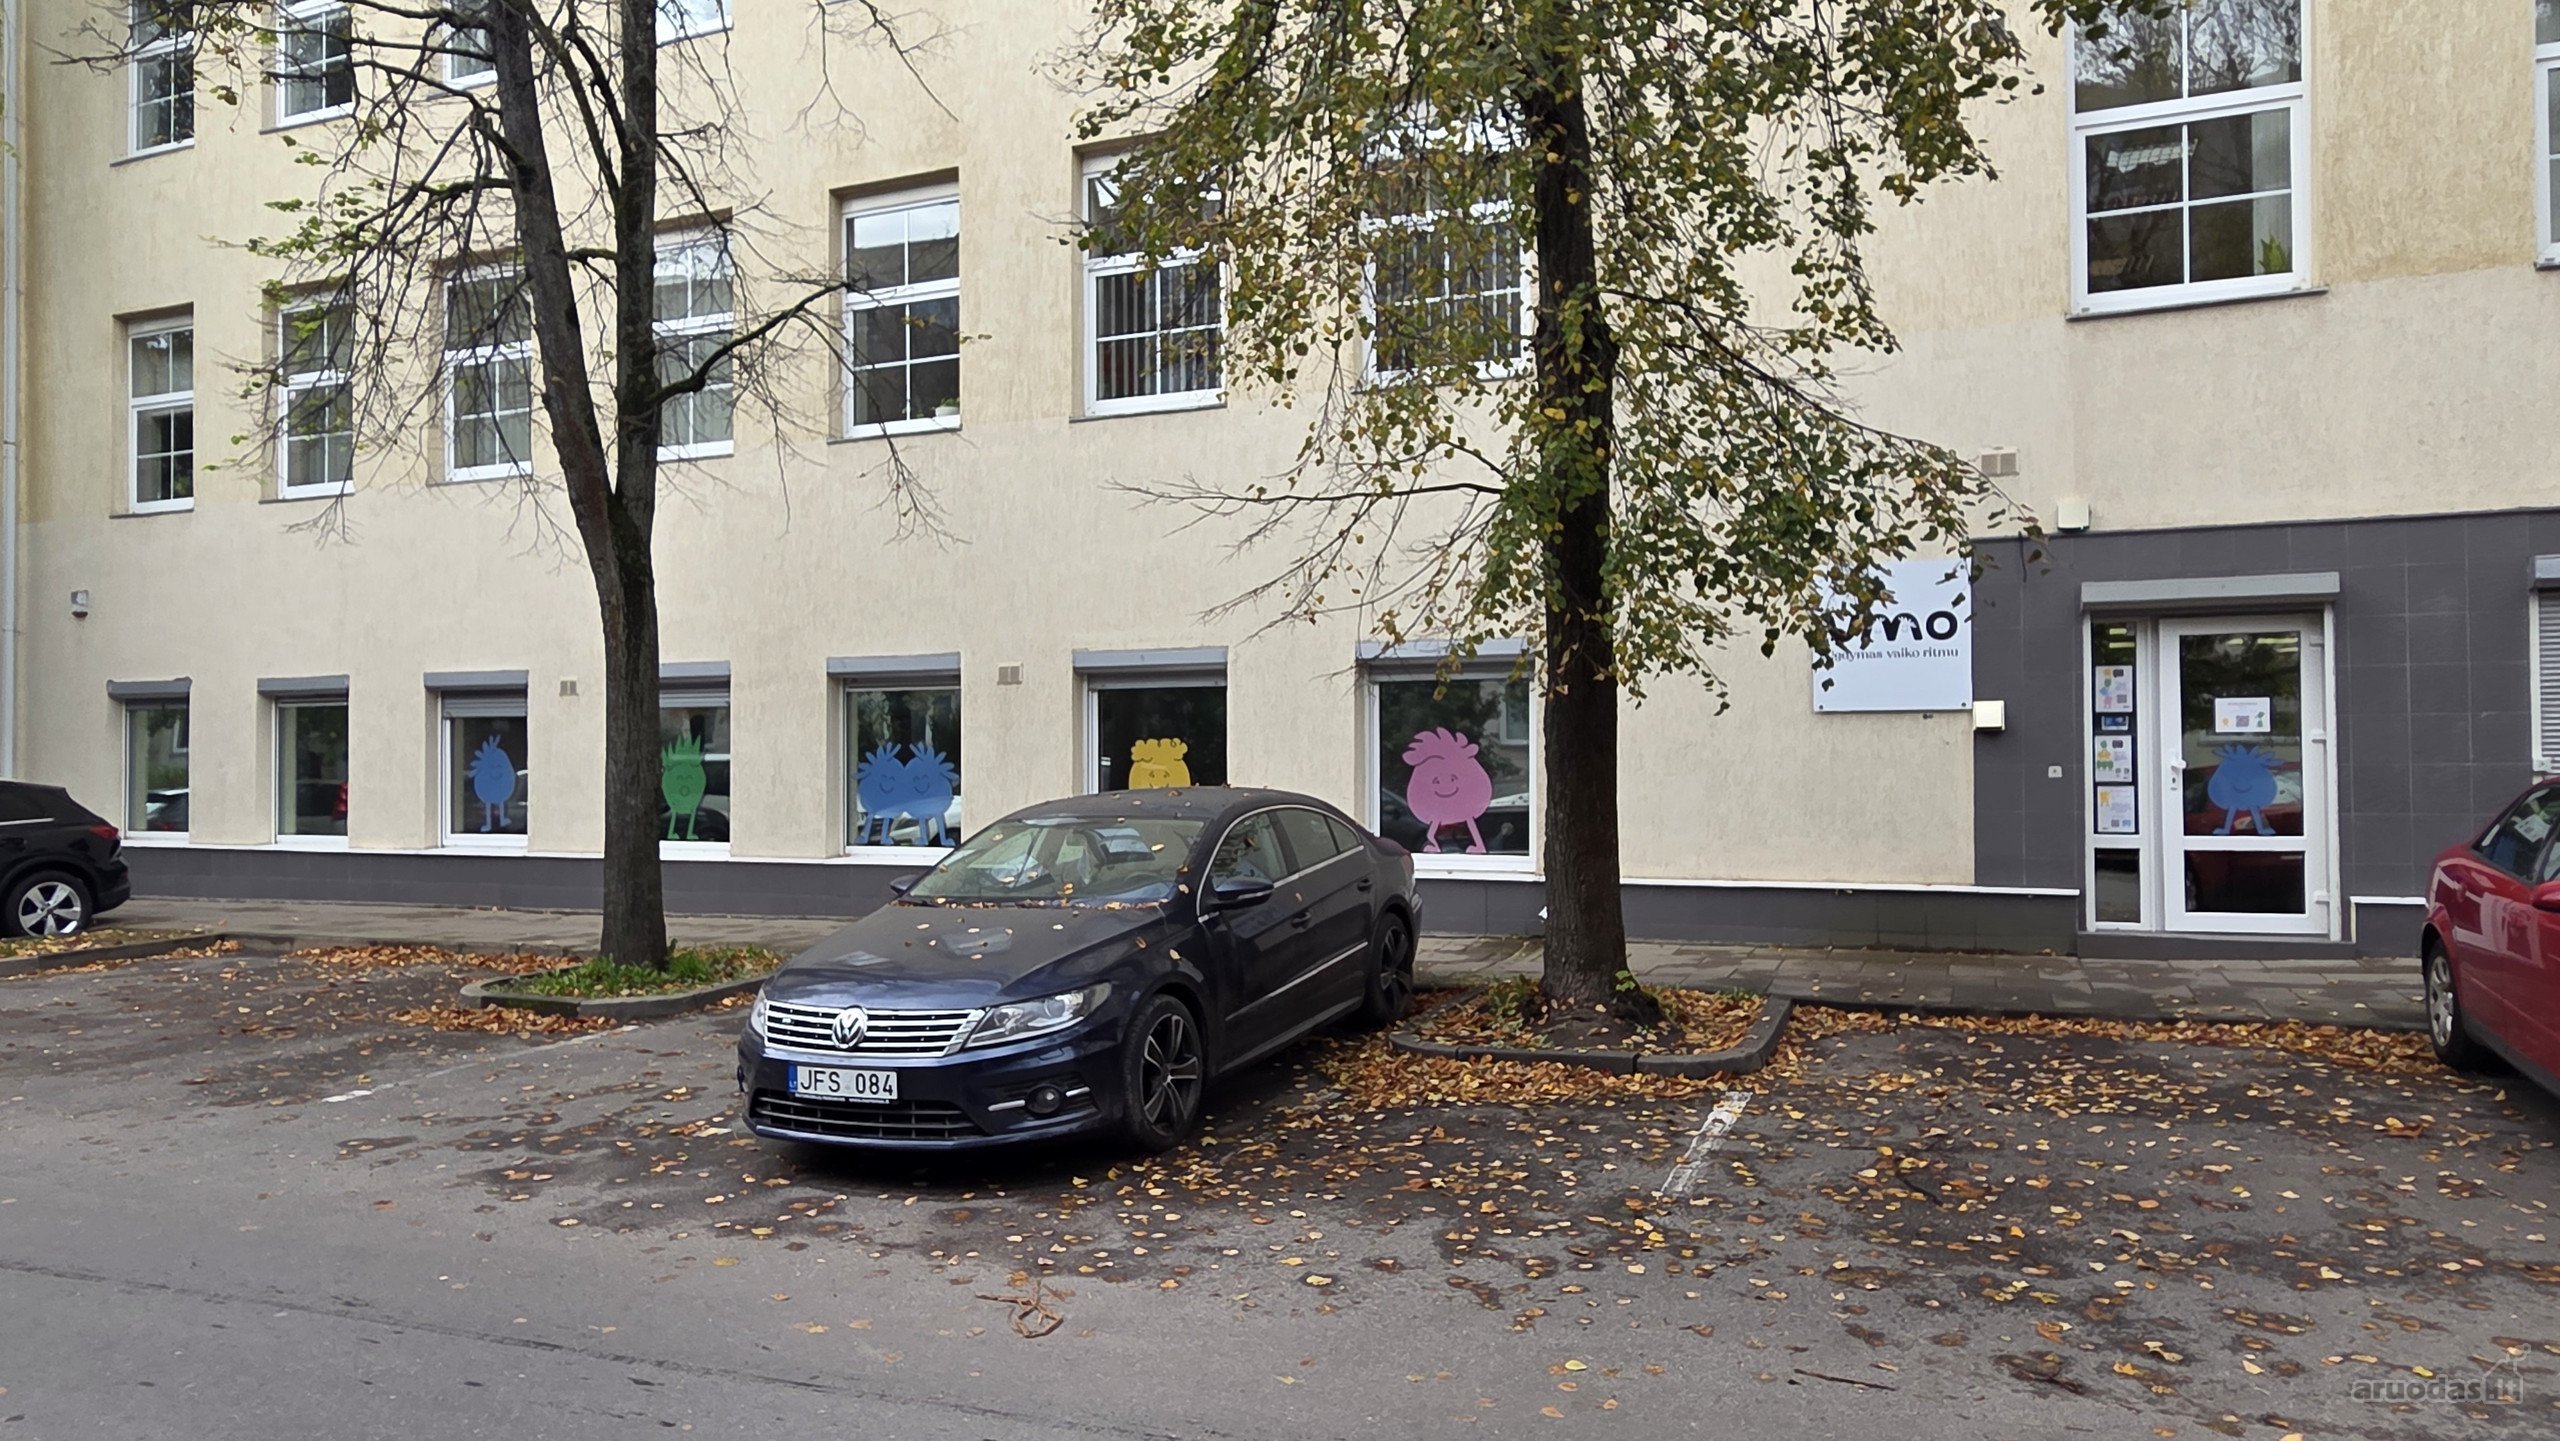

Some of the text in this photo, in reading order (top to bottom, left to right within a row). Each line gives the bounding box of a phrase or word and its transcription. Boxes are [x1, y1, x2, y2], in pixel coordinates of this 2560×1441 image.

[1831, 646, 1959, 662] gdymas vaiko ritmu
[800, 1069, 894, 1097] JFS 084
